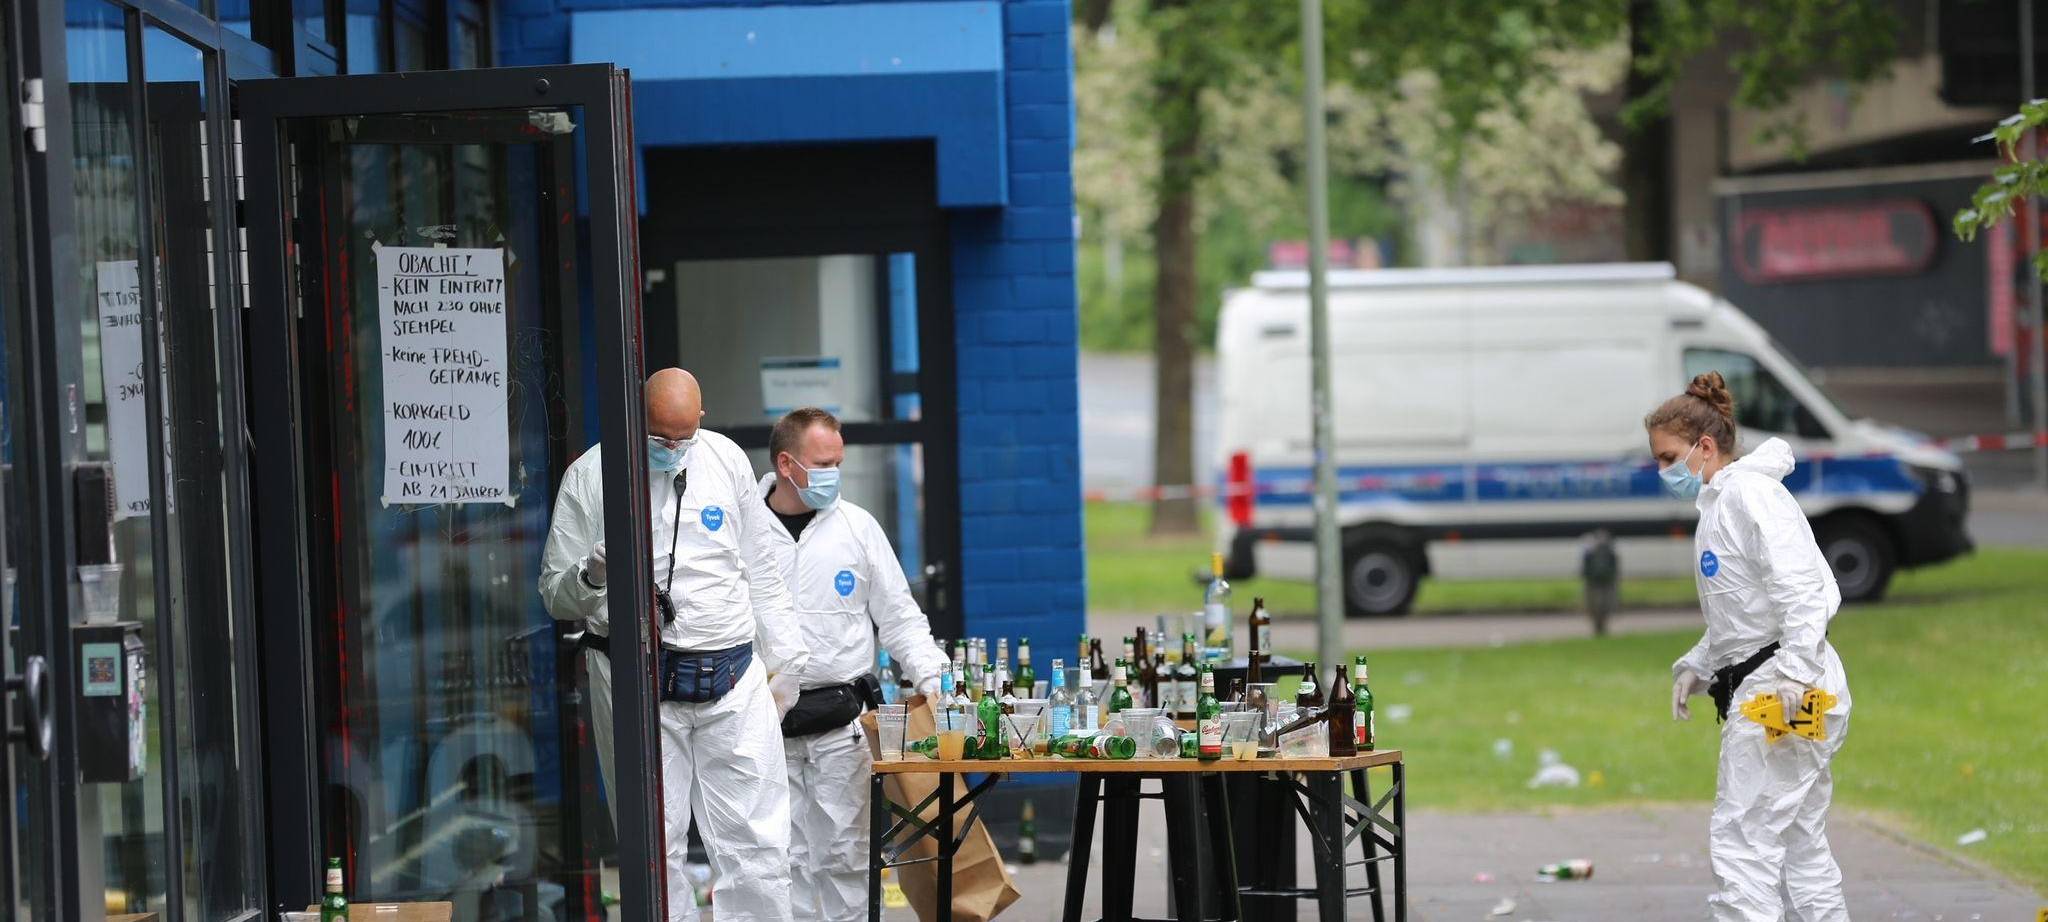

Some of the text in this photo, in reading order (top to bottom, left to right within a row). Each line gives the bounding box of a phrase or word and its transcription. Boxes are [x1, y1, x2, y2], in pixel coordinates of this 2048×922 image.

[393, 277, 429, 296] KEIN
[440, 278, 503, 295] EINTRITT
[393, 300, 429, 316] NACH
[393, 319, 457, 336] STEMPEL
[402, 482, 422, 497] AB
[430, 484, 447, 498] 21
[706, 513, 720, 522] Tyvek
